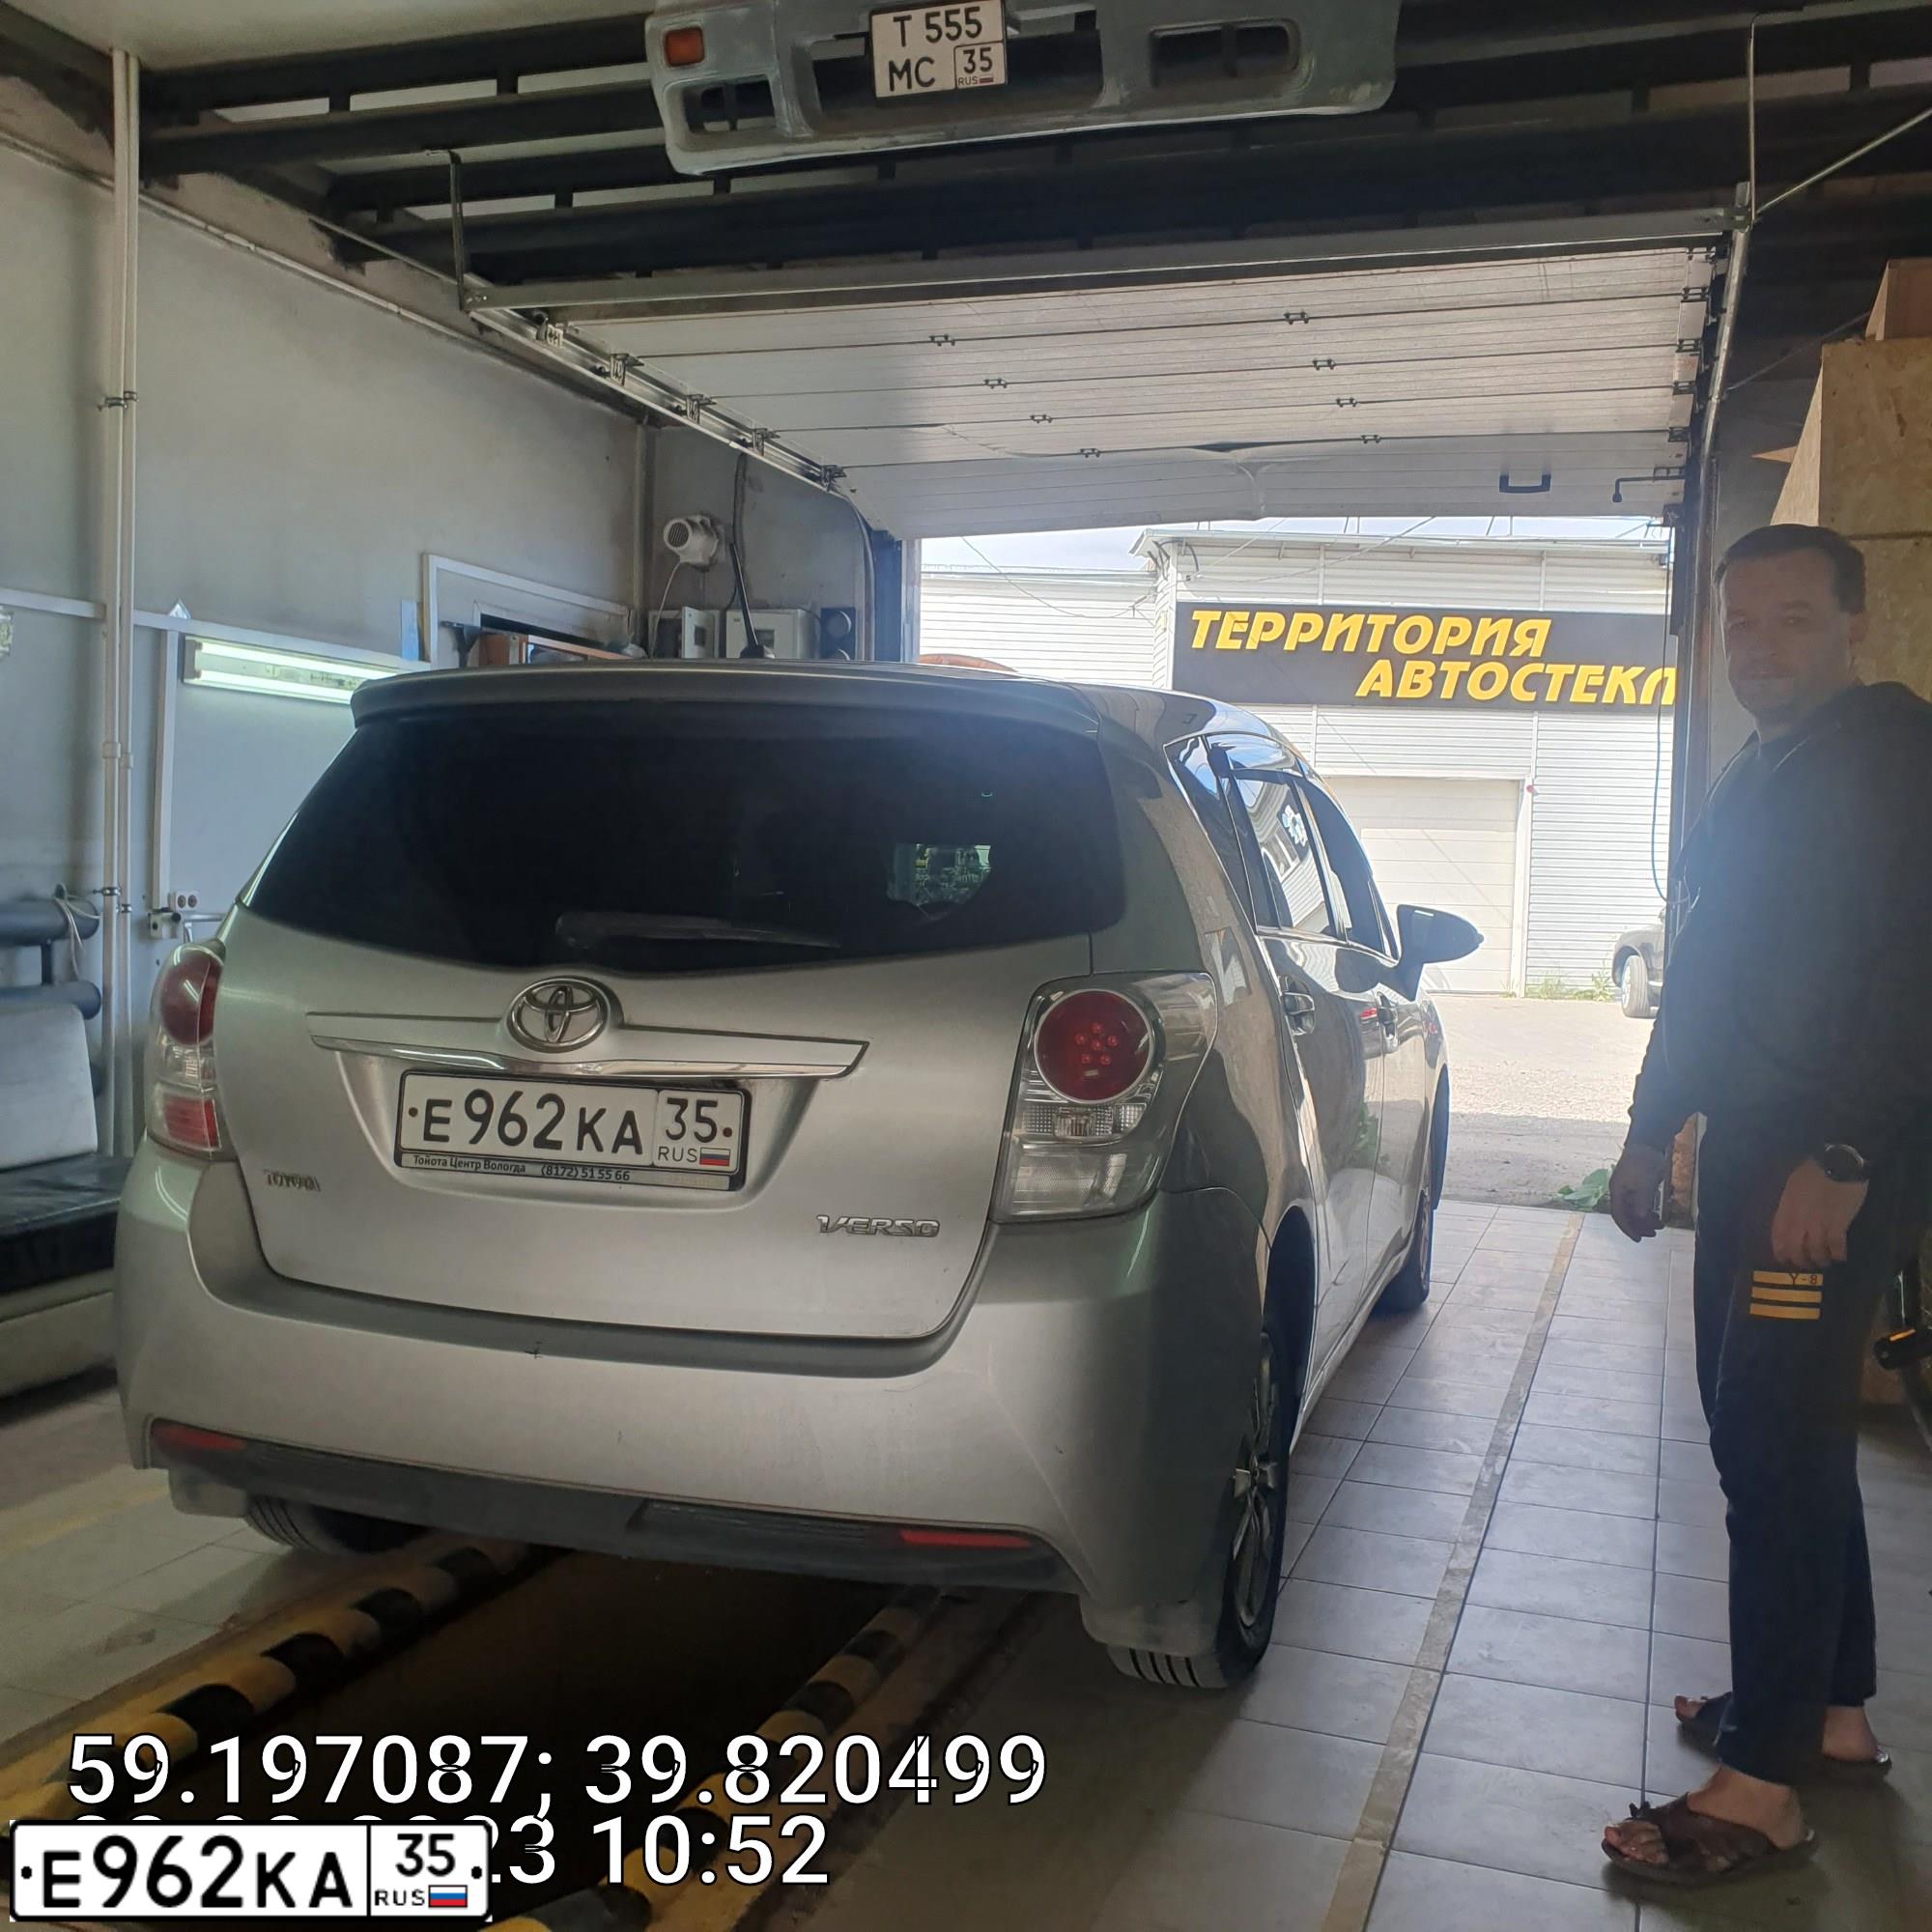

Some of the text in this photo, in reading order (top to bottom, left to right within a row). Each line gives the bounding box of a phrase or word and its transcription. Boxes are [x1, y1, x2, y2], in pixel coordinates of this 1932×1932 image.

[892, 6, 982, 47] Т 555
[888, 56, 935, 92] МС
[963, 47, 993, 73] 35
[957, 76, 979, 86] RUS
[1190, 609, 1552, 658] ТЕРРИТОРИЯ
[423, 1089, 643, 1155] Е962КА
[665, 1097, 719, 1143] 35
[413, 1153, 631, 1182] Тойота Центр Вологда (8172) 51 55 66
[657, 1147, 697, 1163] RUS
[816, 1214, 941, 1237] VERSO
